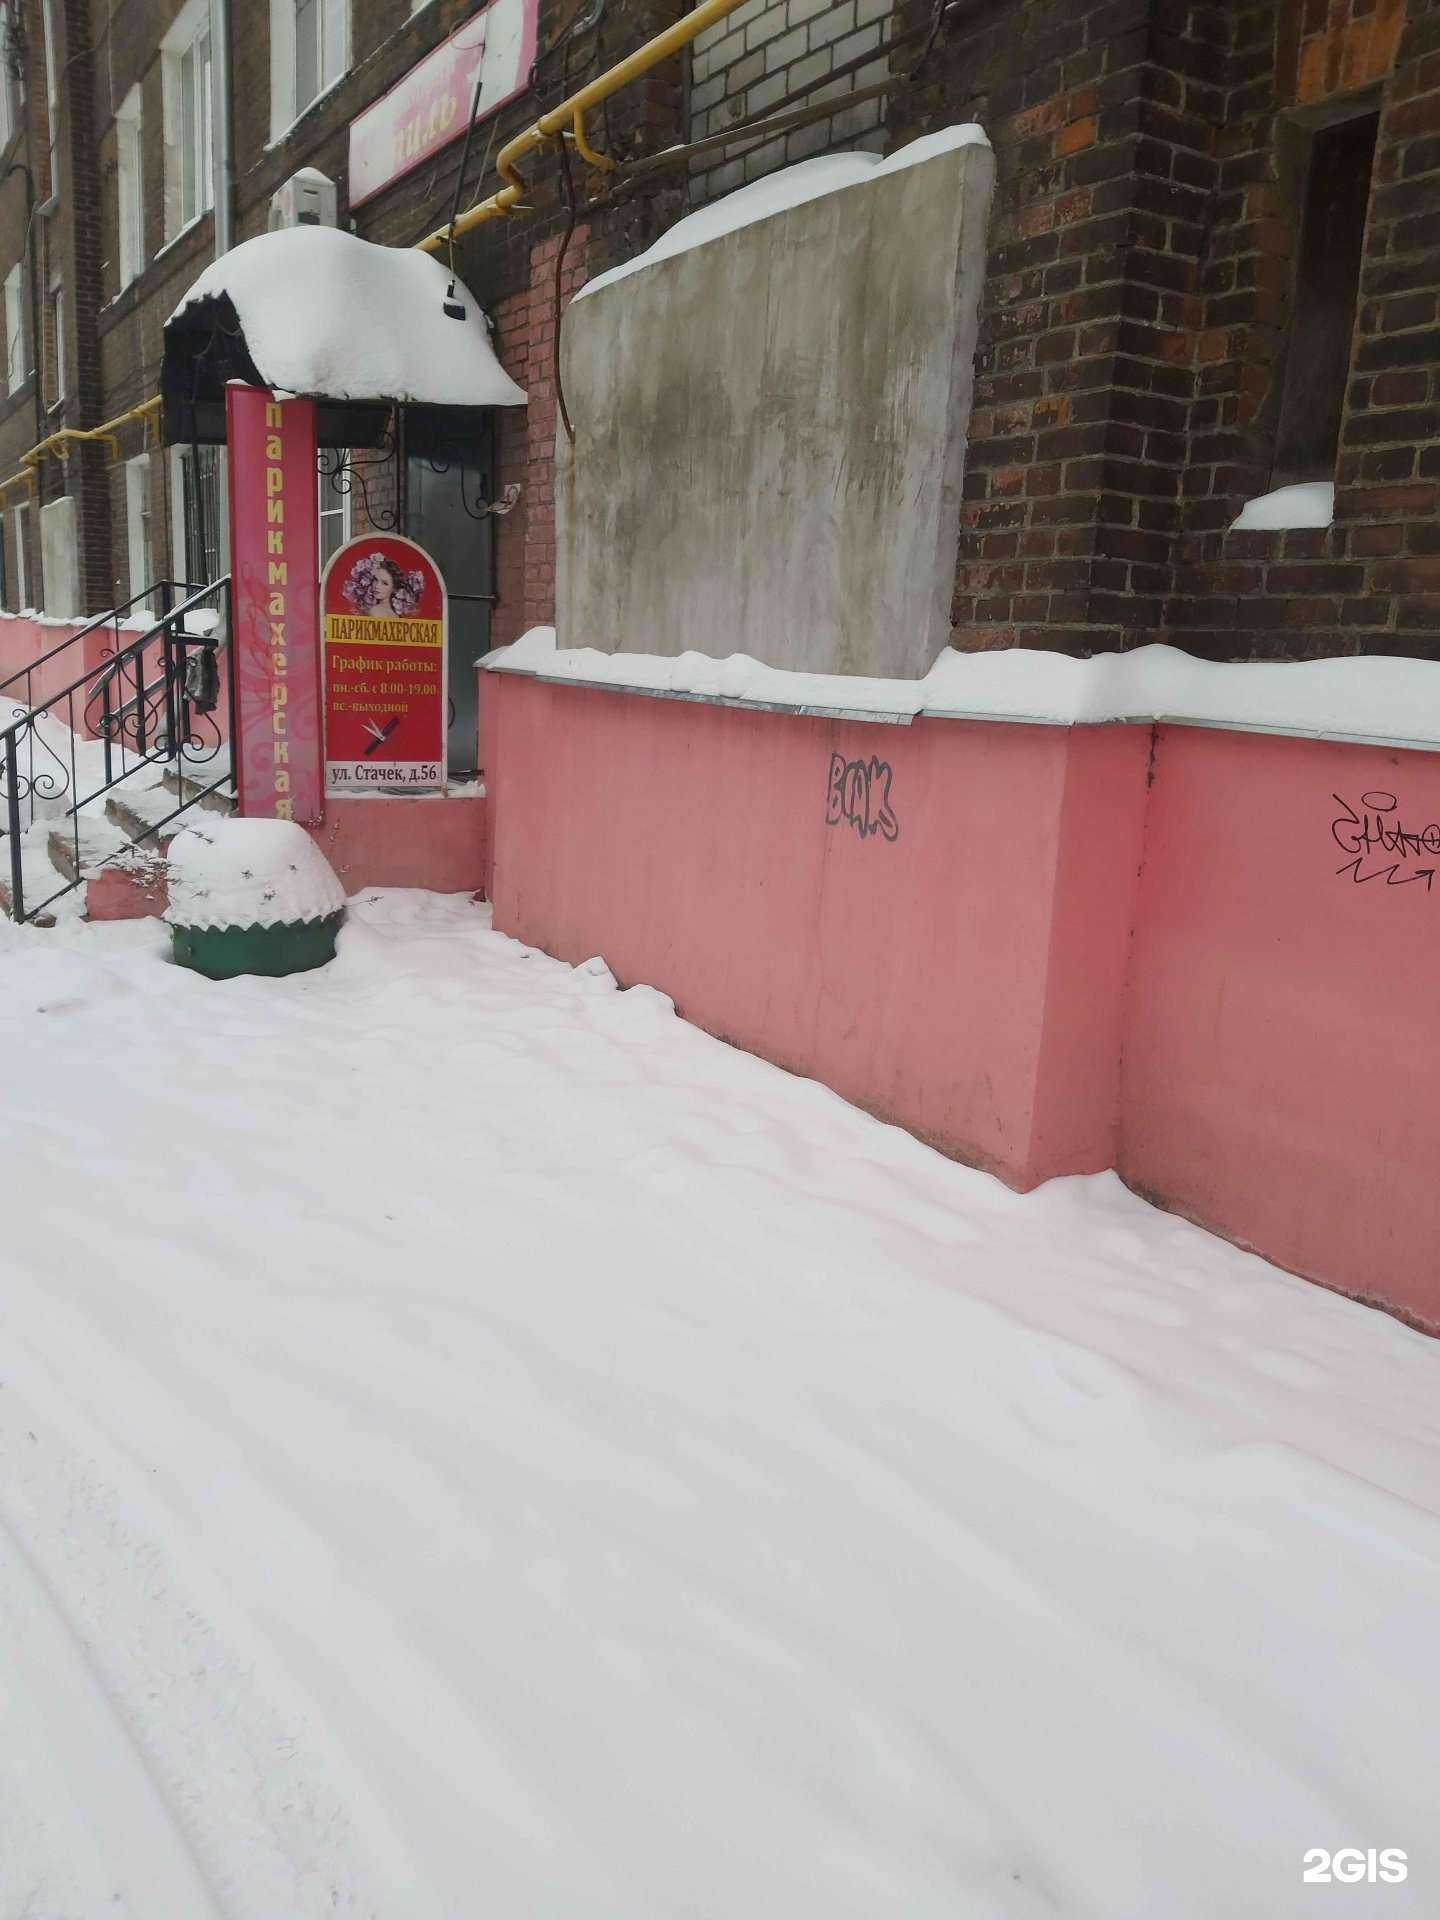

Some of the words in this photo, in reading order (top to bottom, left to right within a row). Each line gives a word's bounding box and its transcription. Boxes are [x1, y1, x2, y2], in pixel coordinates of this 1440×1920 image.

[265, 402, 292, 820] парикмахерская
[331, 618, 438, 644] ПАРИКМАХЕРСКАЯ
[332, 654, 383, 673] График
[386, 658, 437, 674] работы:
[332, 768, 351, 784] ул.
[355, 764, 406, 782] Стачек,
[409, 764, 437, 783] д.56
